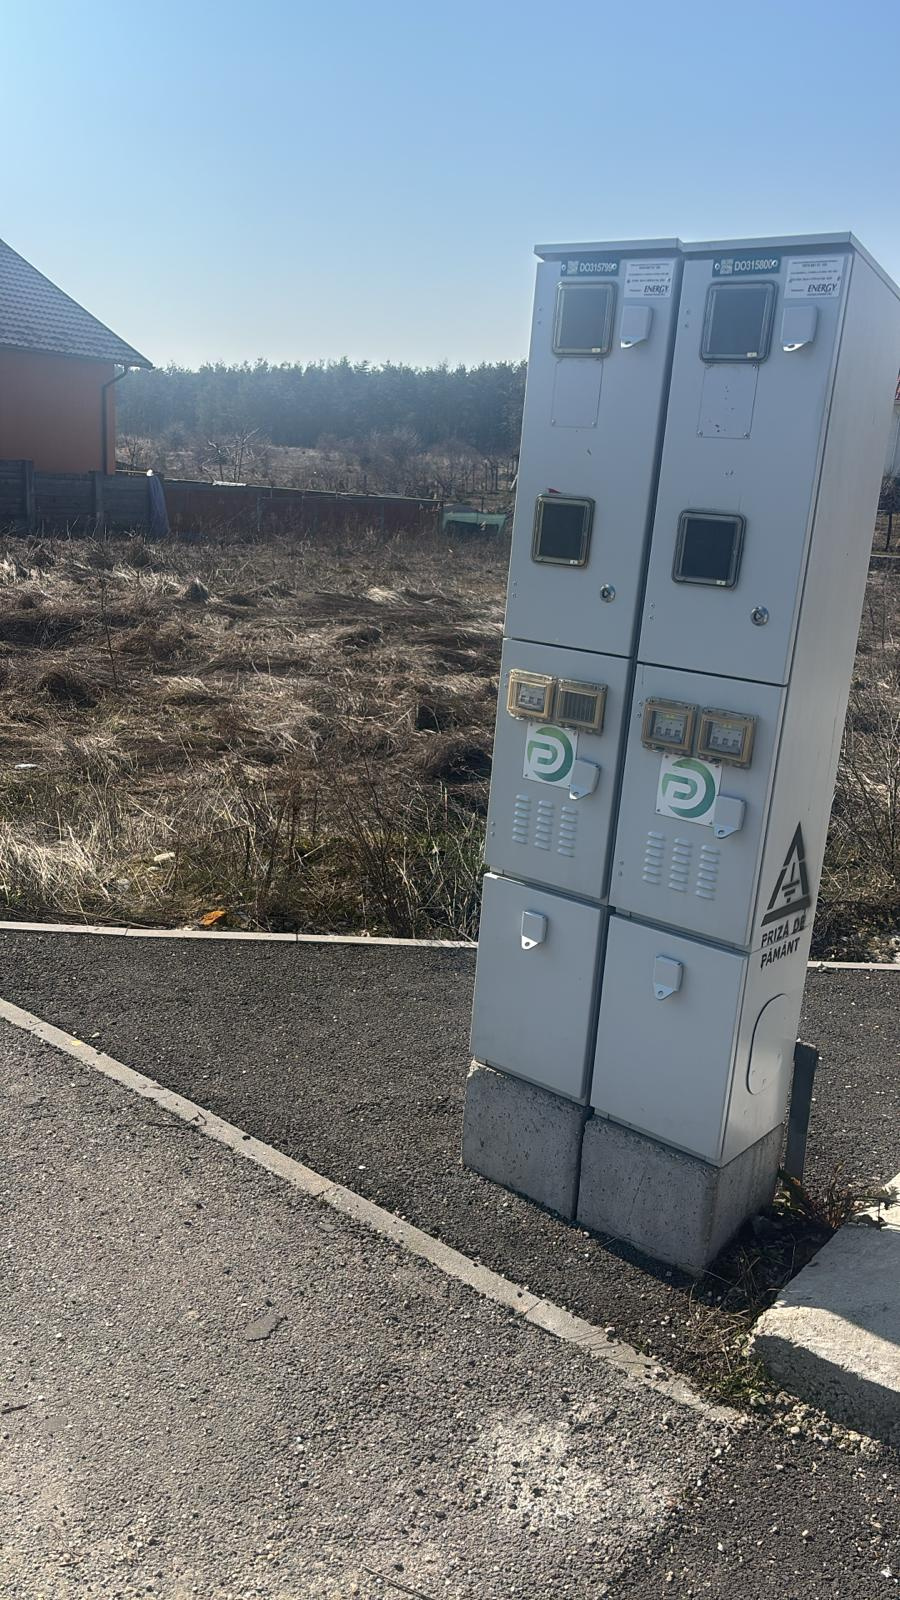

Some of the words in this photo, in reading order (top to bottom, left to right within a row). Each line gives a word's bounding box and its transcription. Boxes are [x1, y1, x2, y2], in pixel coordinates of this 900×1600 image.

[643, 284, 669, 293] ENERGY
[807, 283, 838, 293] ENERGY
[791, 914, 806, 935] DE
